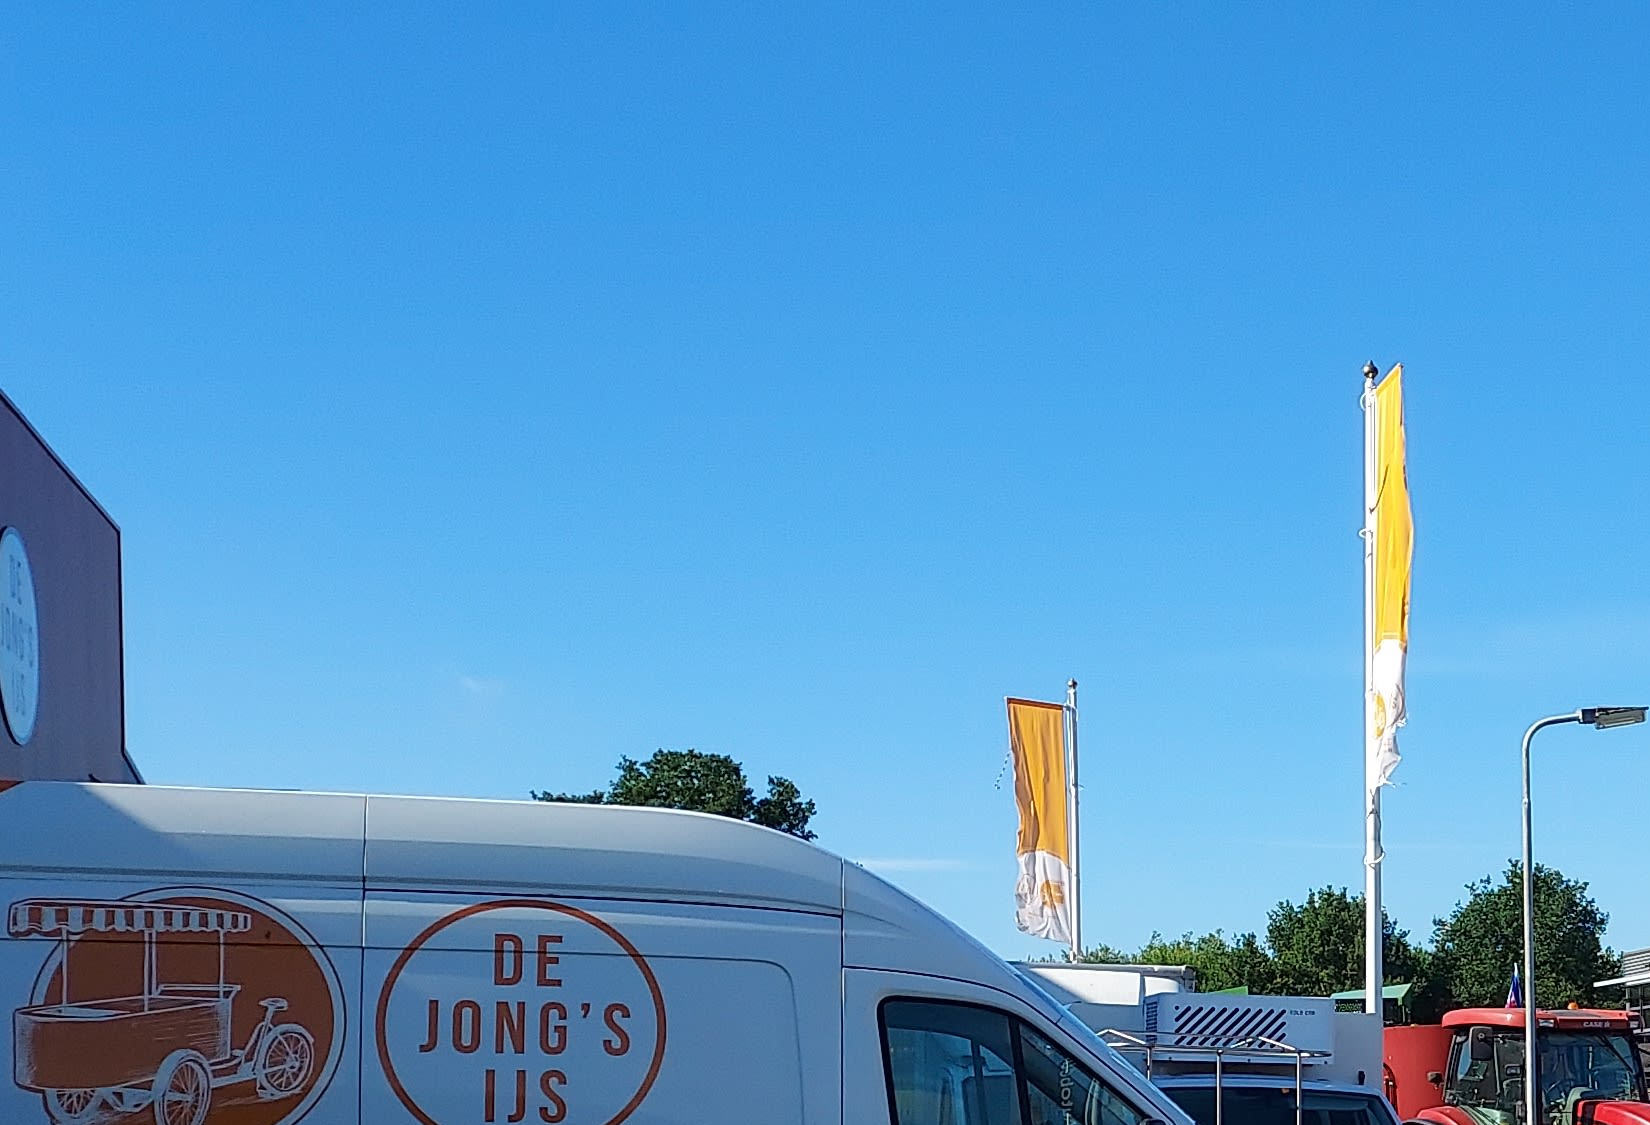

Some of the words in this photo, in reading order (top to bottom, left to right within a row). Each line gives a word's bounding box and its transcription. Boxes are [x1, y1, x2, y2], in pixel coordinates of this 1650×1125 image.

[493, 933, 563, 987] DE
[419, 1000, 632, 1057] JONG'S
[484, 1069, 568, 1123] IJS
